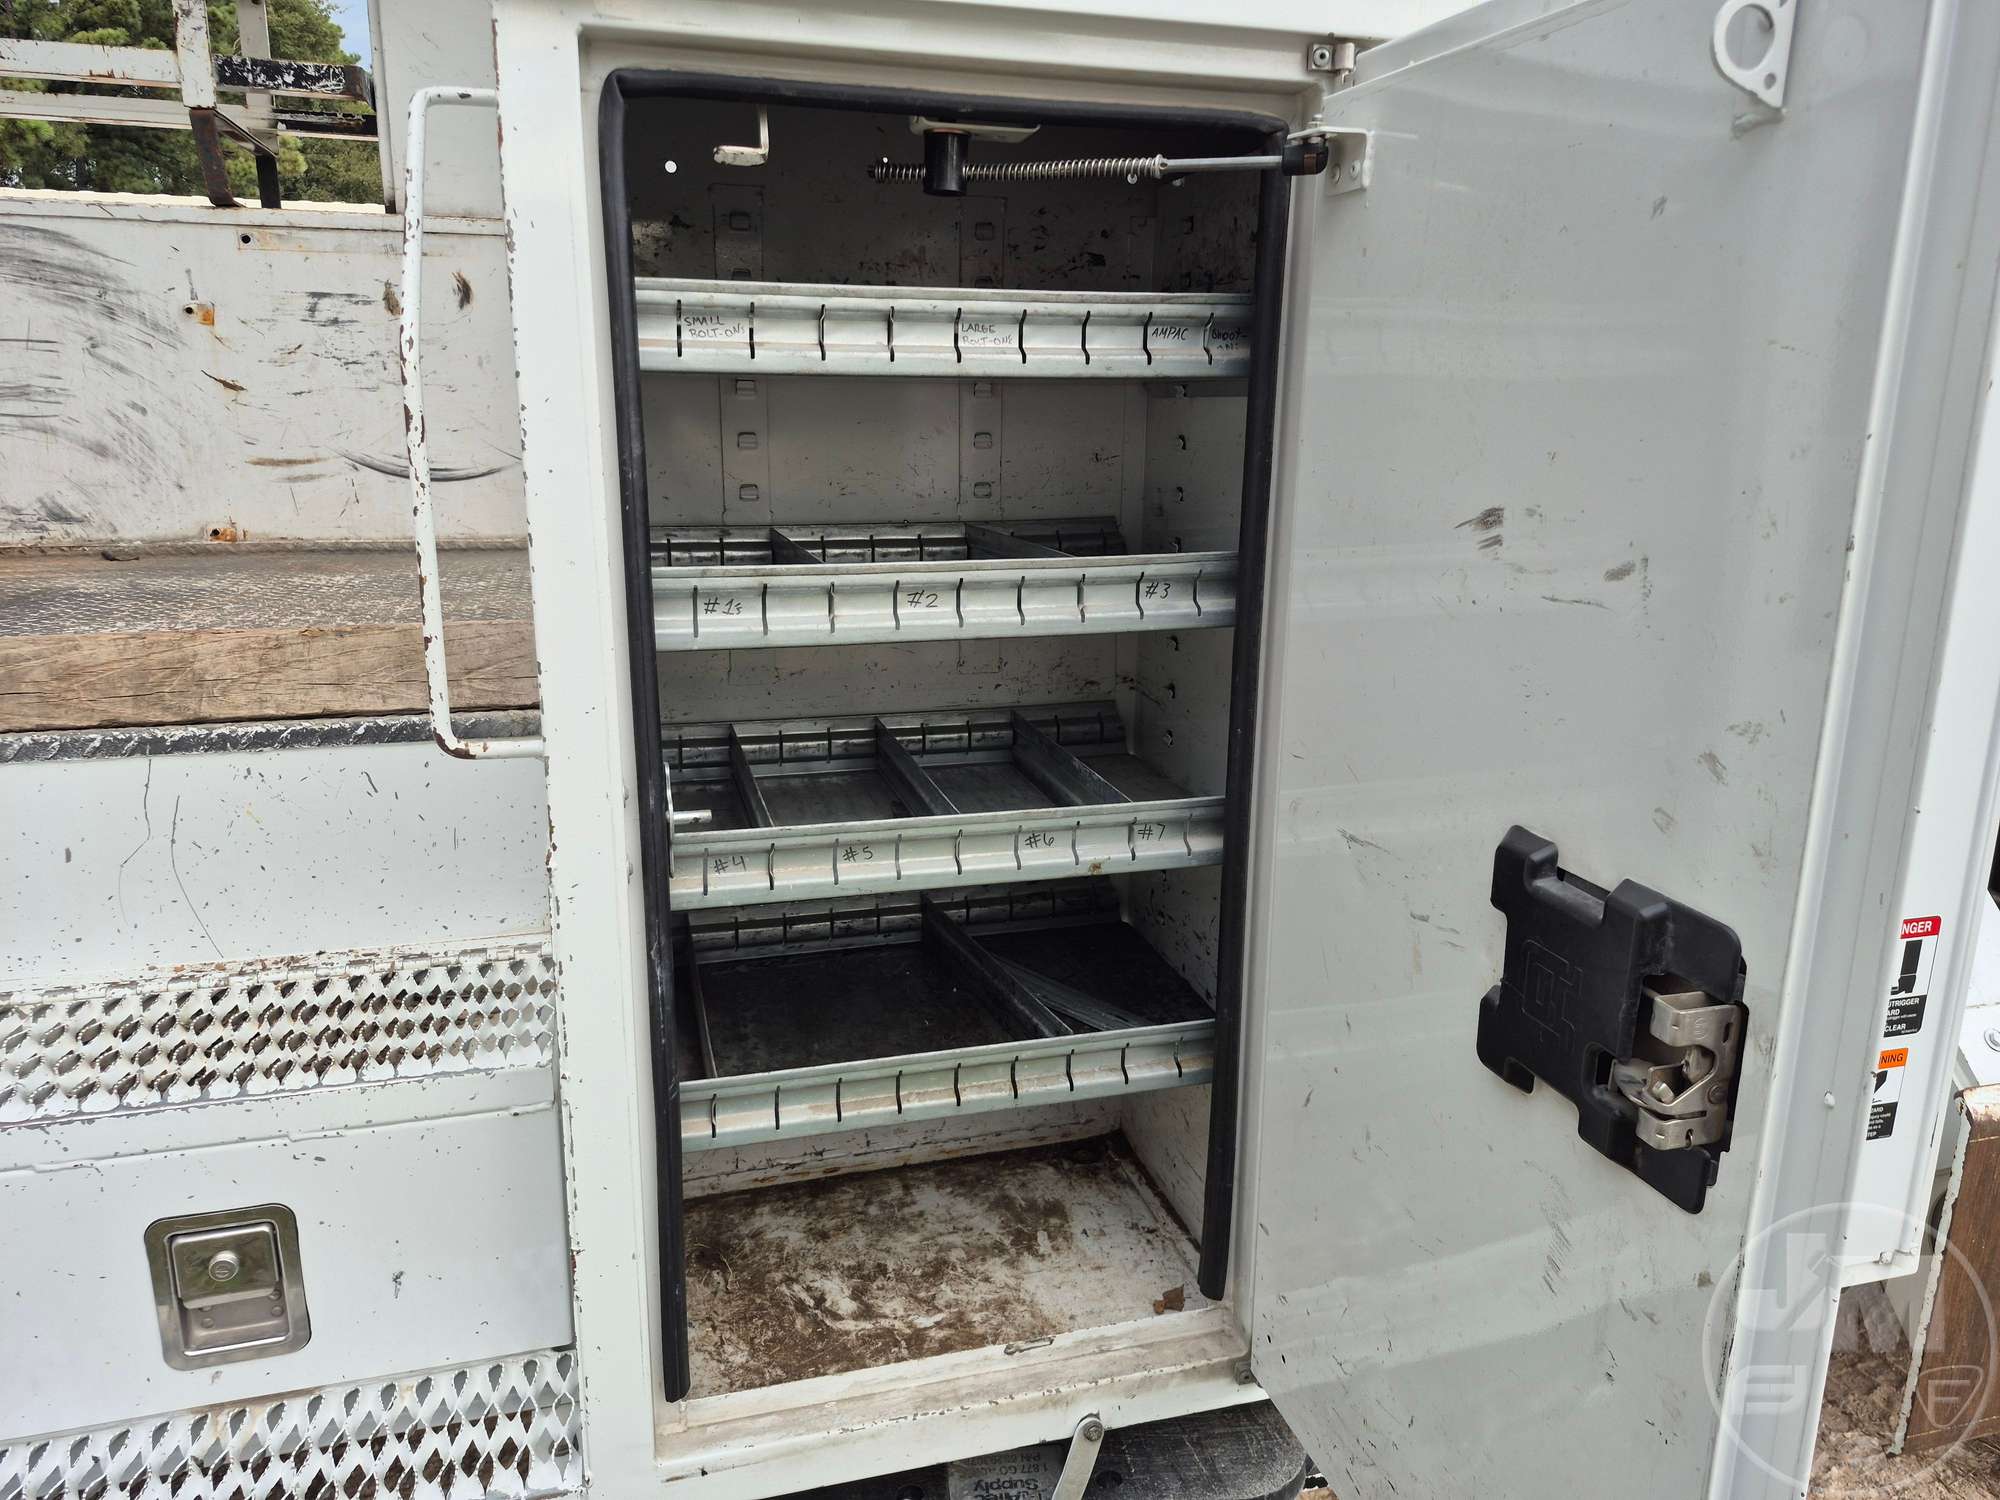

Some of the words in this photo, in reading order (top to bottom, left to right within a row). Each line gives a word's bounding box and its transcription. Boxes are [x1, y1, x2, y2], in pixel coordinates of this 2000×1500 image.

[960, 323, 997, 335] LARGE
[1151, 326, 1190, 342] AMPAC
[906, 589, 939, 609] #2
[1144, 581, 1172, 600] #3
[1023, 831, 1056, 849] #6
[1137, 822, 1167, 841] #7
[841, 846, 874, 863] #5
[712, 855, 747, 874] #4
[1884, 1023, 1907, 1033] CLEAR
[973, 1477, 1039, 1495] Supply
